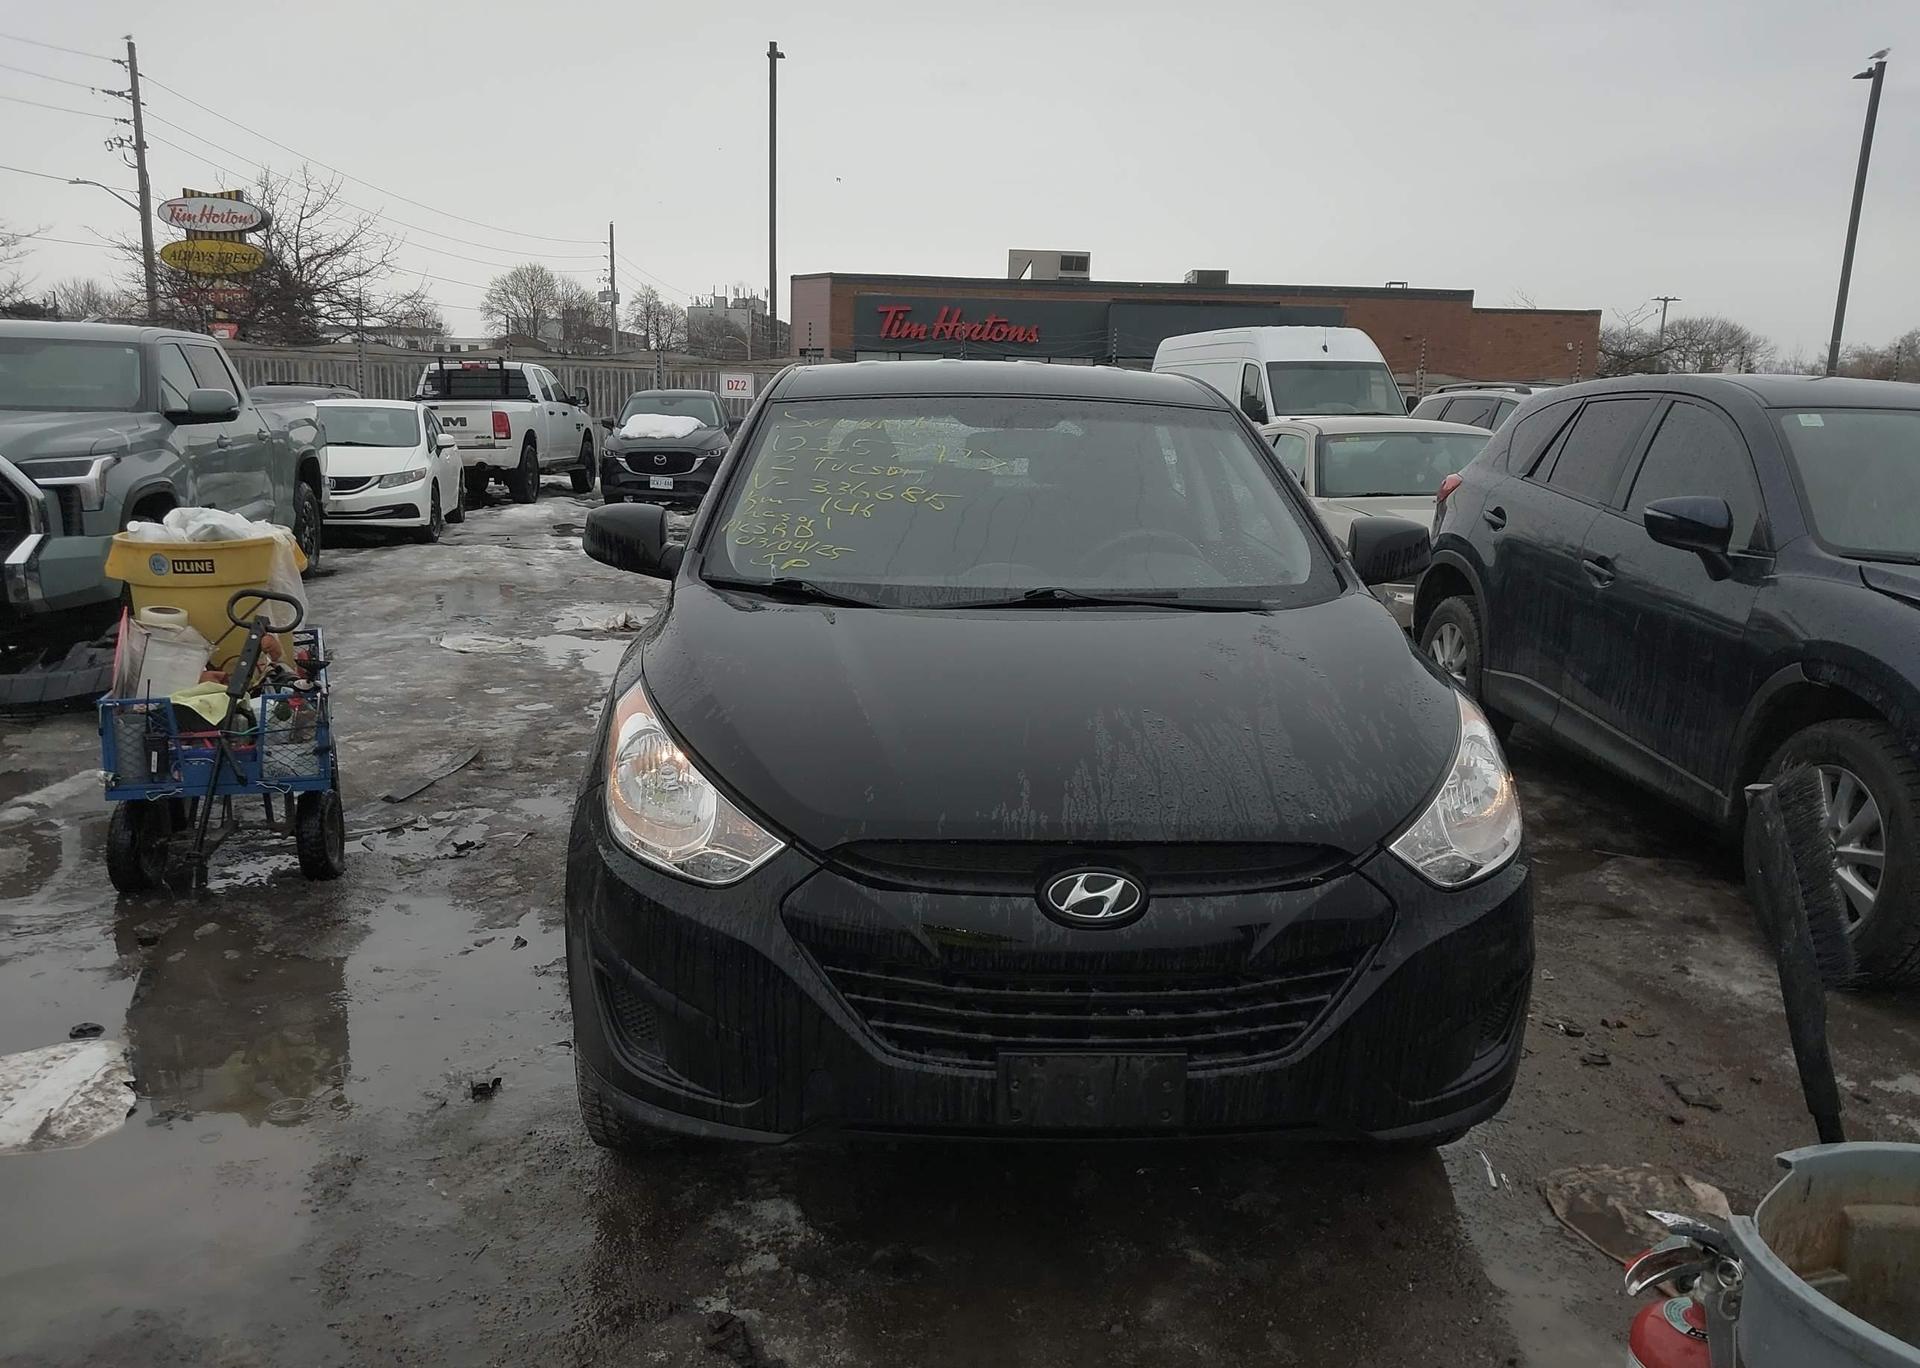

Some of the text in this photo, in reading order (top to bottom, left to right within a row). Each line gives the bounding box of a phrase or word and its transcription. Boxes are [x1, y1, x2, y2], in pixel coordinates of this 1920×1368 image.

[167, 203, 255, 225] Tim Hortons
[170, 250, 257, 265] ALWAYS FRESH
[878, 304, 1039, 344] Tim Hortons
[727, 379, 747, 391] DZ2
[173, 561, 213, 573] ULINE
